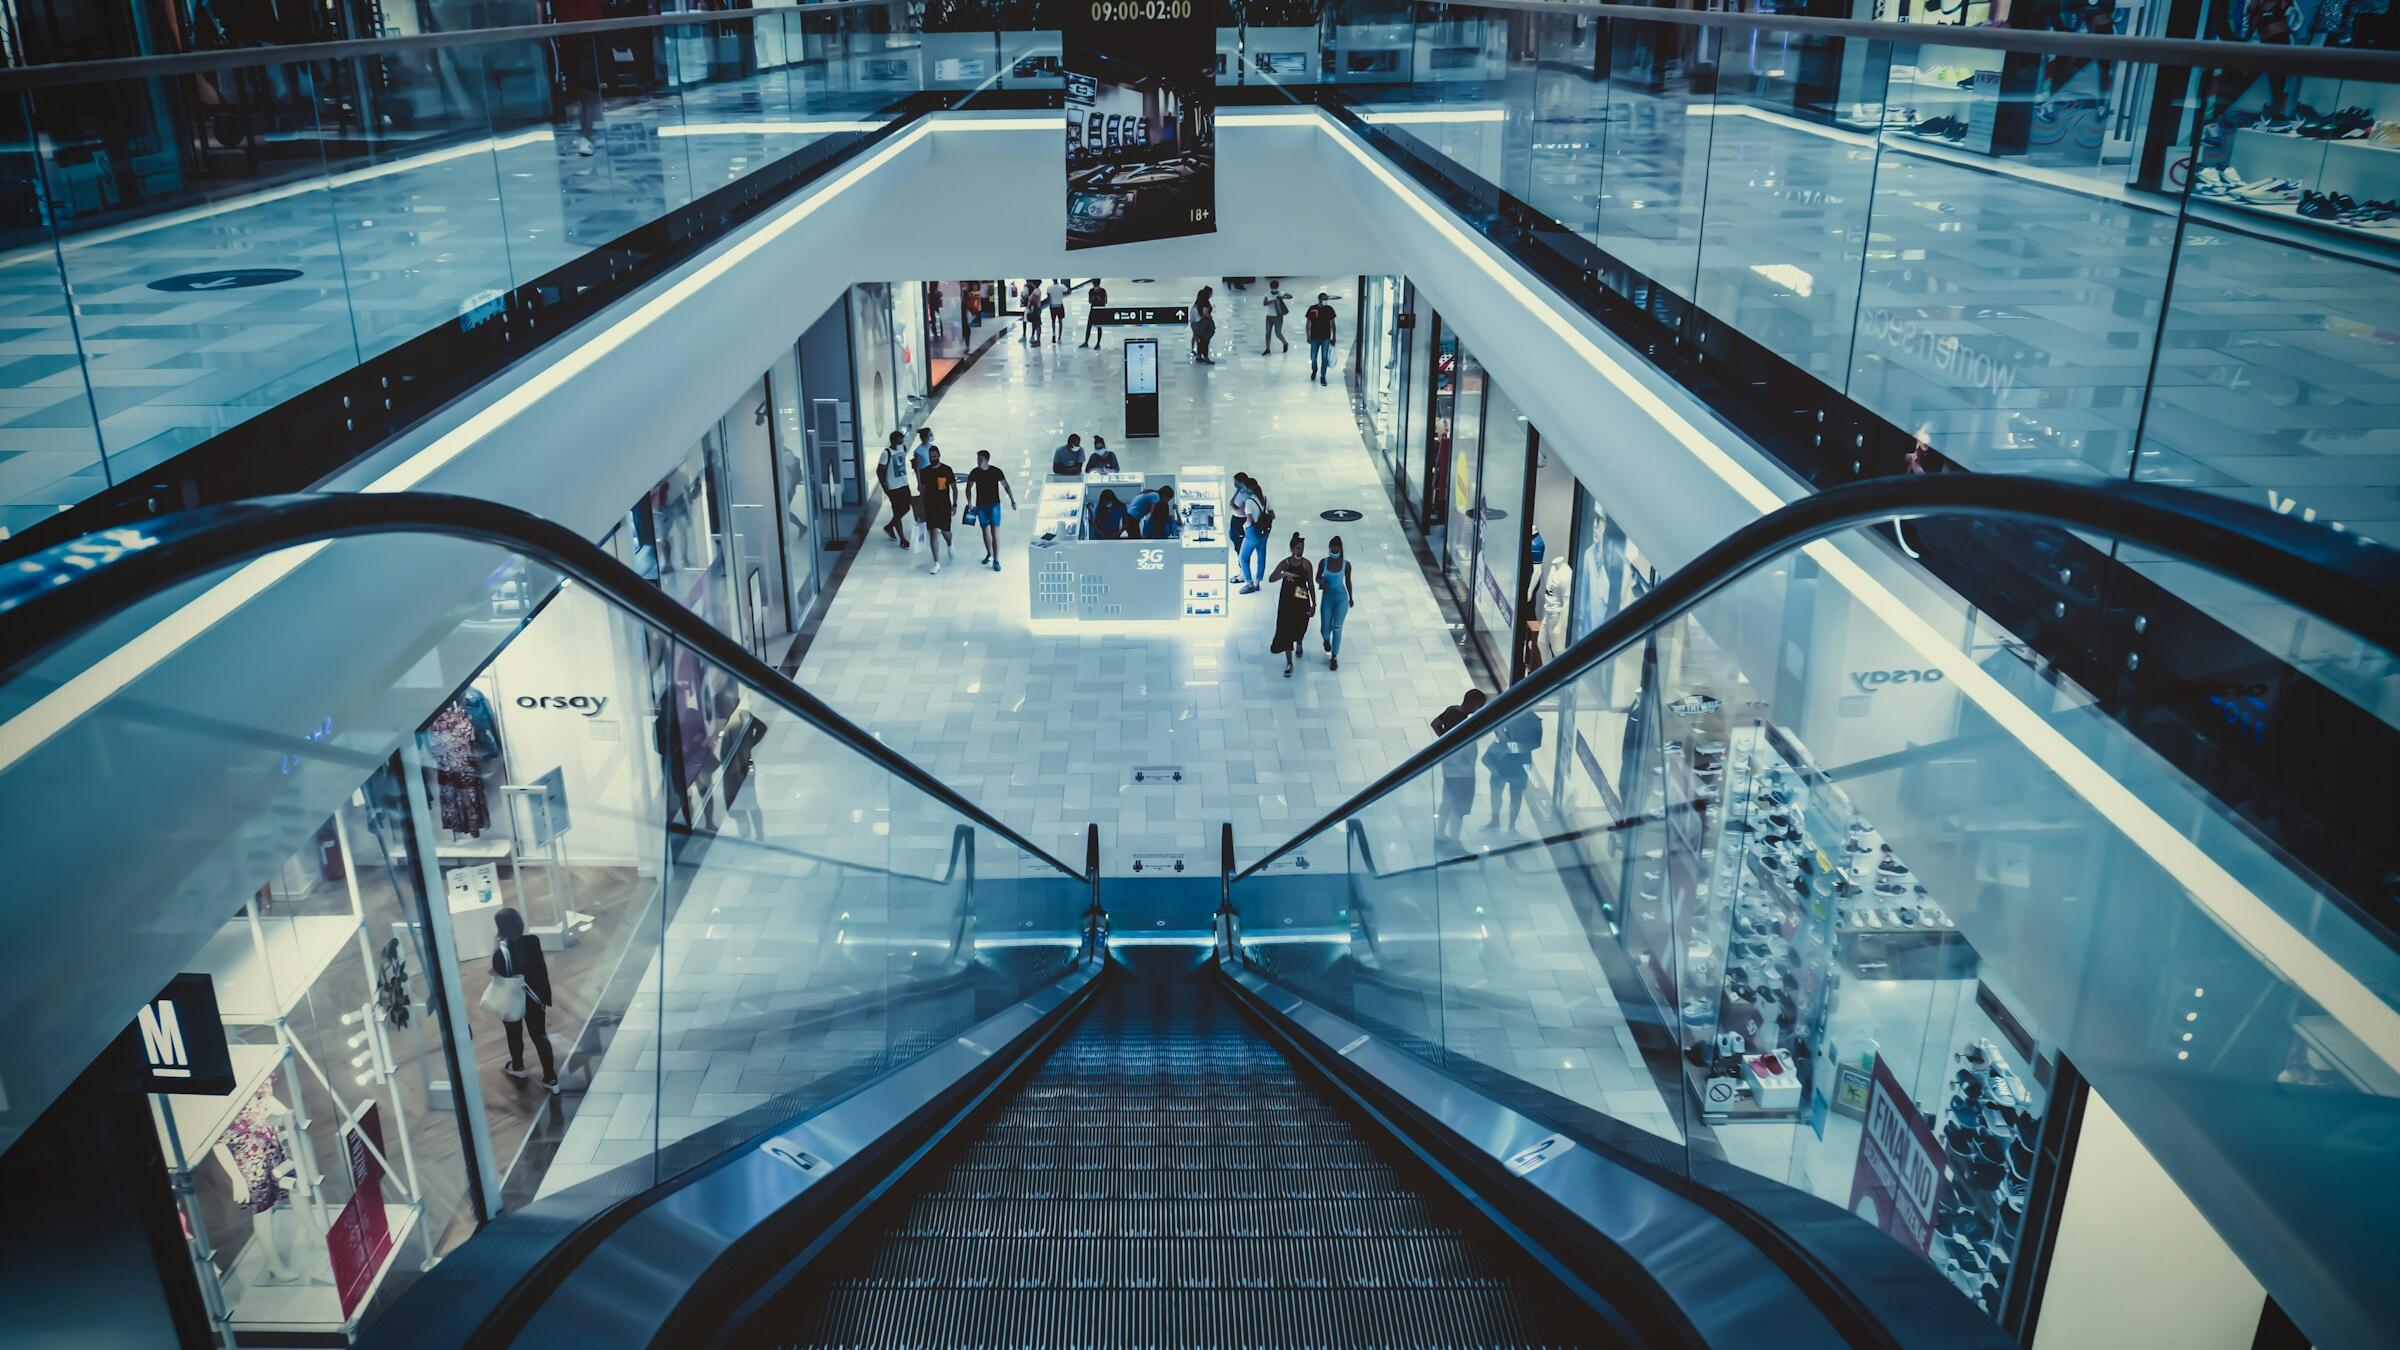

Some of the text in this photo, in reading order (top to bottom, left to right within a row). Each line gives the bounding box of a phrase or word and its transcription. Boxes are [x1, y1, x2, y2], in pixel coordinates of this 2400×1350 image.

[1091, 0, 1191, 21] 09:00-02:00
[1190, 208, 1209, 222] 18+
[1136, 559, 1165, 570] Store
[1139, 548, 1164, 562] 3G
[516, 696, 609, 717] orsay
[138, 1000, 188, 1066] M
[1873, 1093, 1933, 1209] FINALNO
